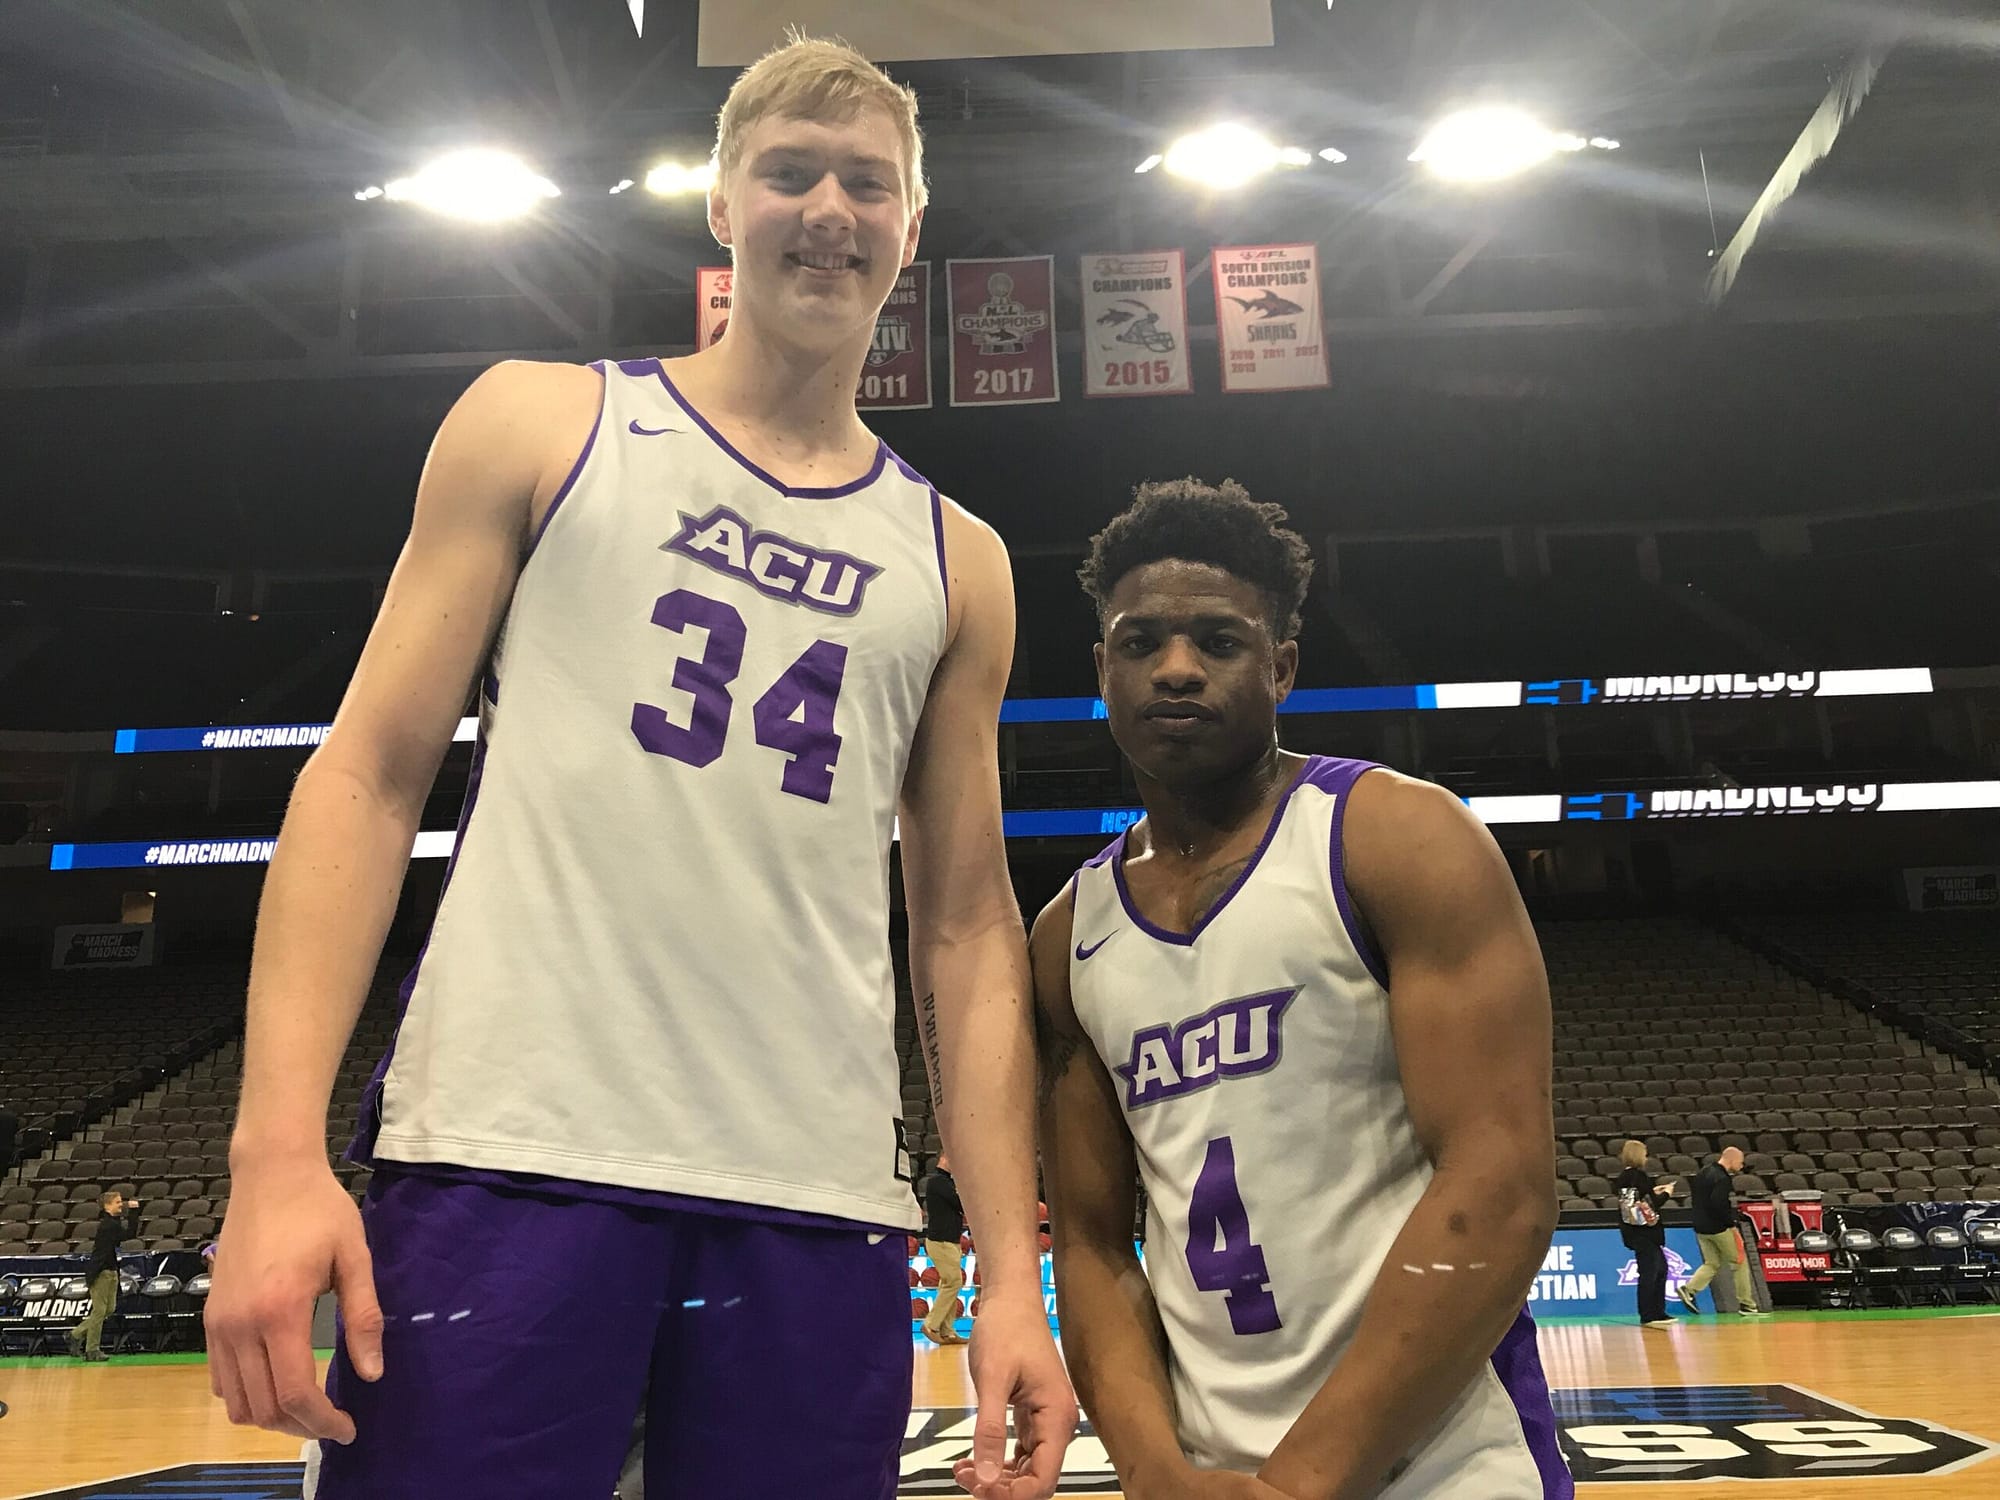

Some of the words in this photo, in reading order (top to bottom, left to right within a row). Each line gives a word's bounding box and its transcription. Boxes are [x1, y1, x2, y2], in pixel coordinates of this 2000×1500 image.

[1221, 263, 1258, 274] SOUTH
[1261, 259, 1311, 272] DIVISION
[1092, 277, 1172, 292] CHAMPIONS
[1227, 272, 1308, 288] CHAMPIONS
[710, 295, 732, 310] CH
[962, 316, 1042, 329] CHAMPIONS
[974, 368, 1034, 394] 2017
[1105, 360, 1170, 386] 2015
[678, 512, 866, 610] ACU
[631, 588, 848, 804] 34
[144, 841, 278, 865] #MARCHMADN
[84, 935, 123, 947] MARCH
[87, 946, 139, 959] MADNESS
[1129, 998, 1281, 1101] ACU
[1185, 1136, 1283, 1335] 4
